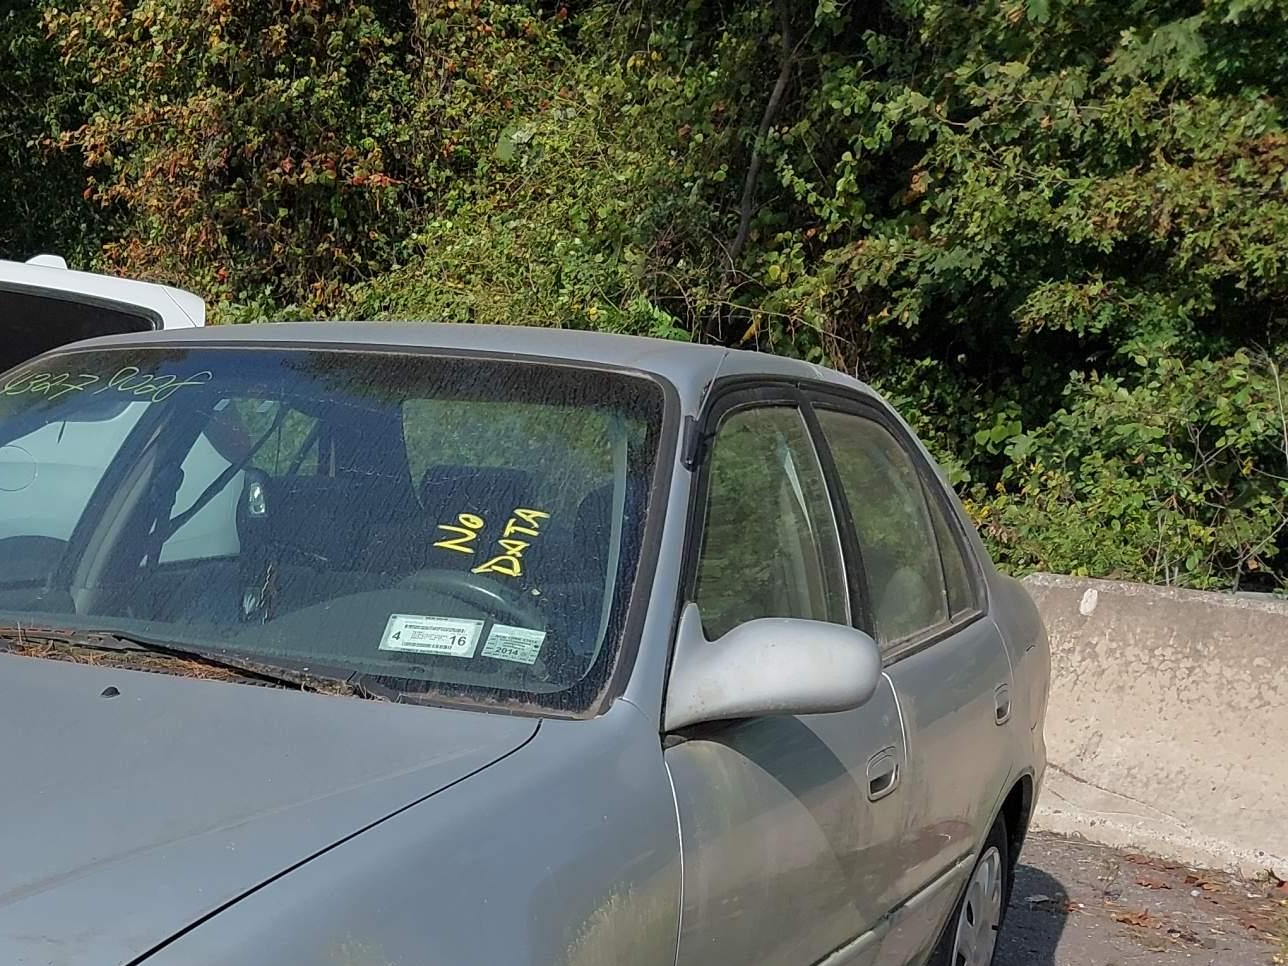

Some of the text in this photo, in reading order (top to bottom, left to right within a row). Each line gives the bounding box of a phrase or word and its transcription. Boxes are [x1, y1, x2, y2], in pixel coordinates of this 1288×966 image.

[470, 507, 552, 577] DATA
[391, 630, 402, 641] 4
[449, 635, 467, 647] 16
[495, 646, 519, 656] 2014
